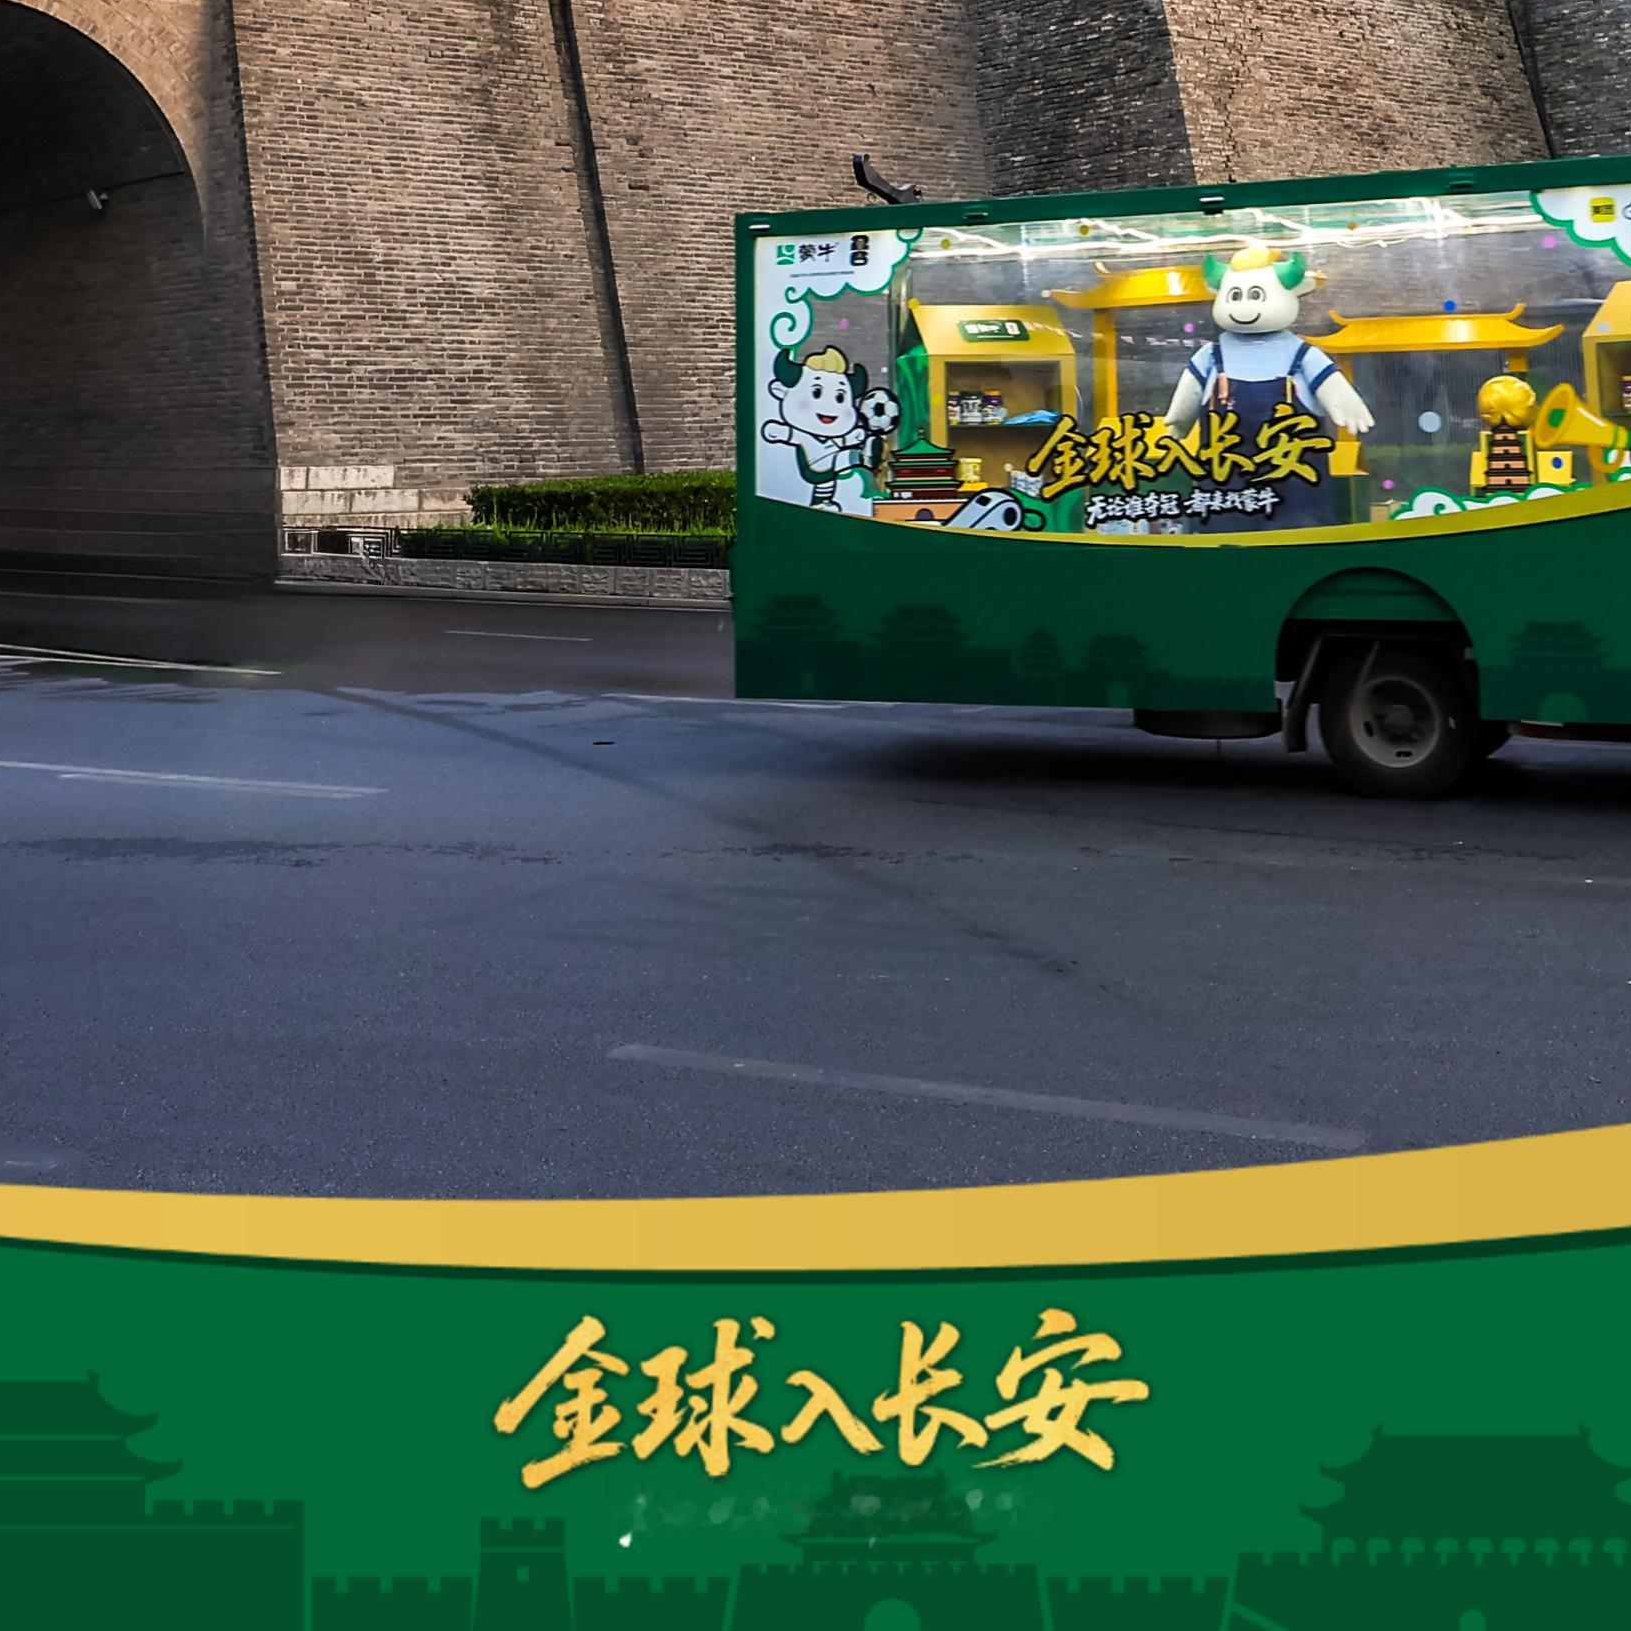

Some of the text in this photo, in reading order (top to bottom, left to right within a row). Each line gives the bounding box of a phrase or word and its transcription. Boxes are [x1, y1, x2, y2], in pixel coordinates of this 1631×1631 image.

[1086, 491, 1180, 526] 无论谁夺冠
